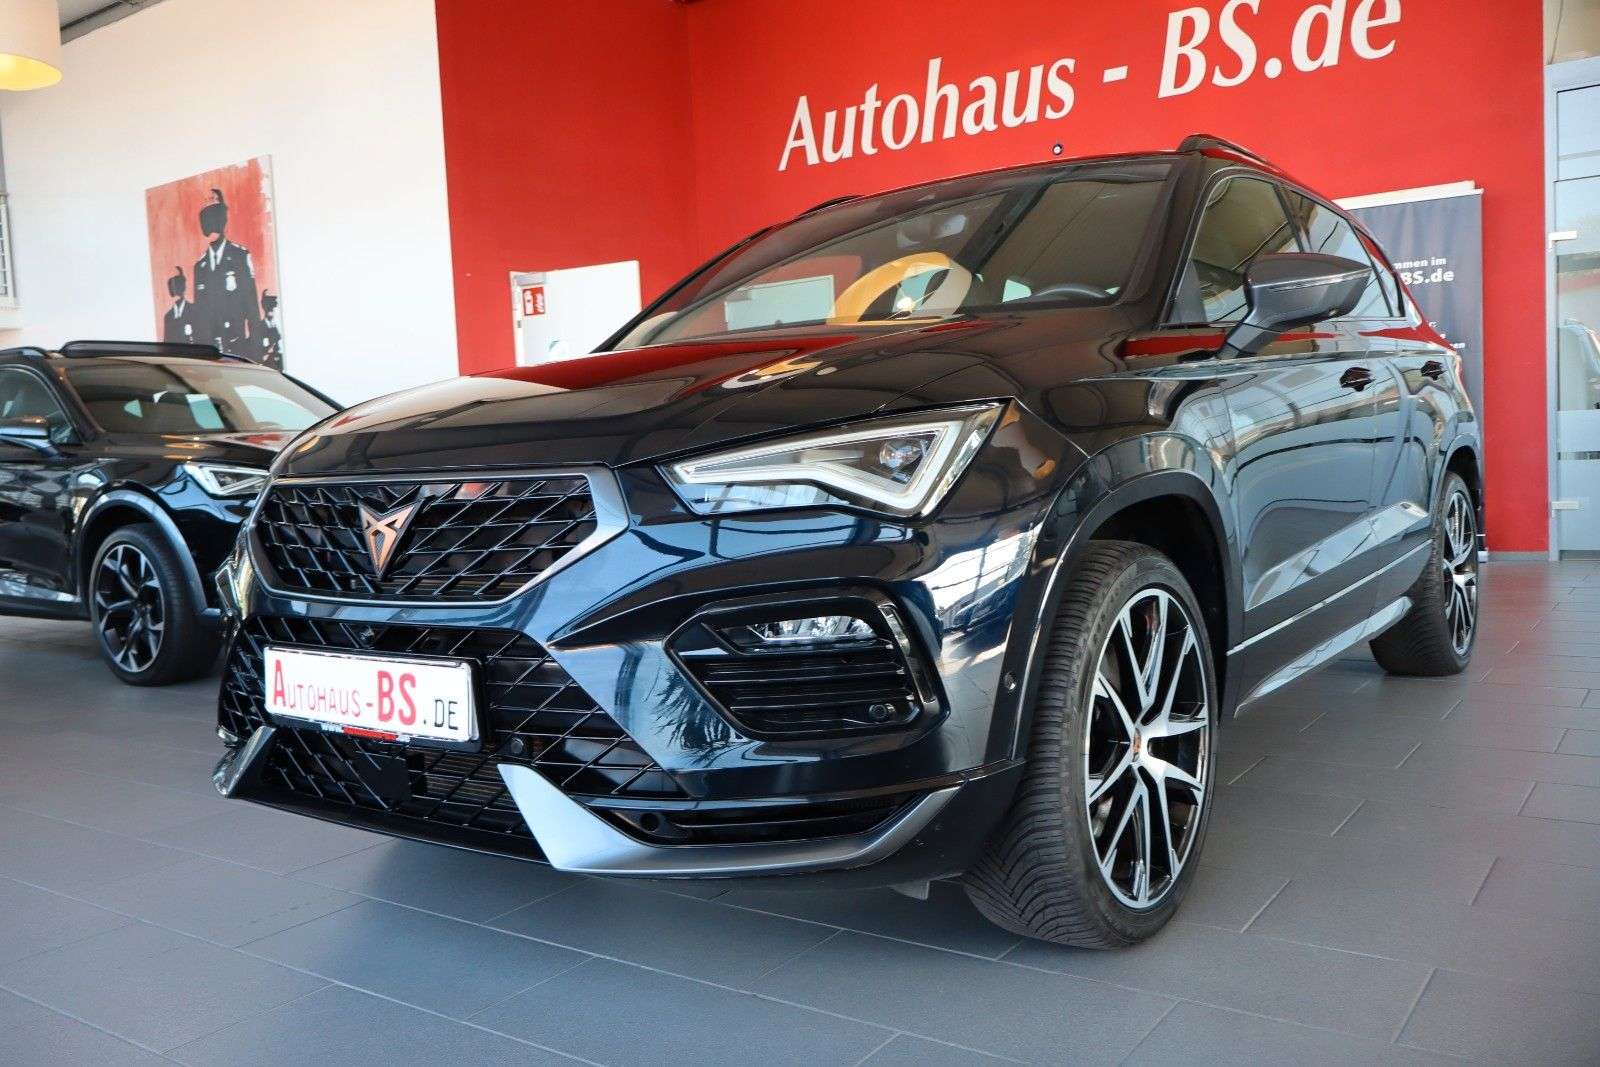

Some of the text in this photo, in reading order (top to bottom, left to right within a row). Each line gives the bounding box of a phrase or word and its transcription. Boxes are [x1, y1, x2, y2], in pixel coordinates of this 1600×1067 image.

[778, 56, 1076, 172] Autohaus
[1157, 0, 1402, 99] BS.de
[1431, 257, 1446, 266] im
